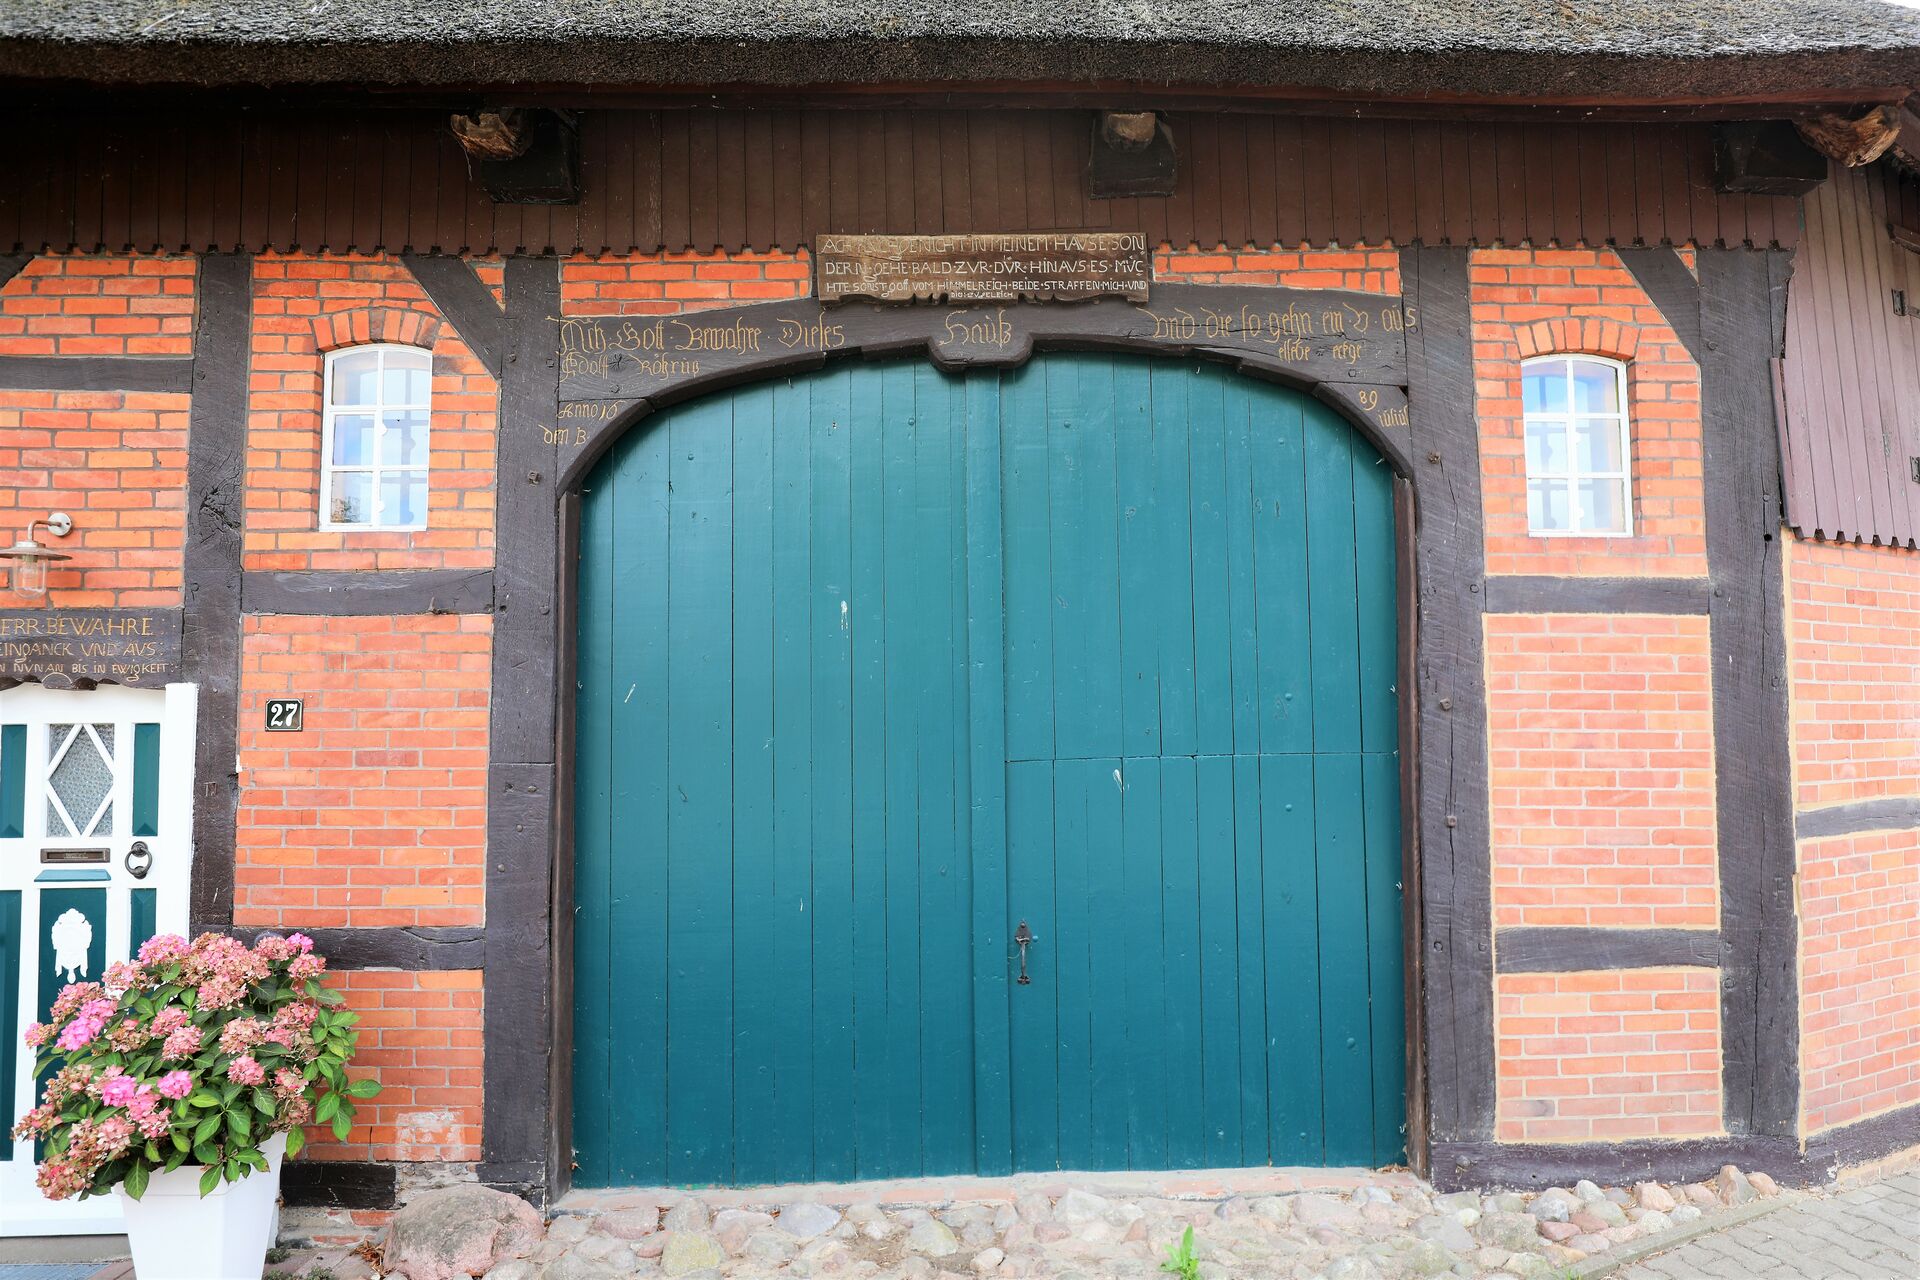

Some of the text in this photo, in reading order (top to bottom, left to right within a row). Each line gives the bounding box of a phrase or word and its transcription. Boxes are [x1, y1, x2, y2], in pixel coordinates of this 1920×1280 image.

[821, 238, 851, 253] ACH
[990, 236, 1048, 251] MEINEM
[1111, 235, 1144, 250] SON
[911, 261, 951, 275] BALD
[1090, 260, 1108, 273] ES
[1044, 280, 1100, 290] STRAFFEN
[1127, 280, 1146, 290] VND
[1359, 390, 1377, 410] 89
[271, 703, 298, 727] 27
